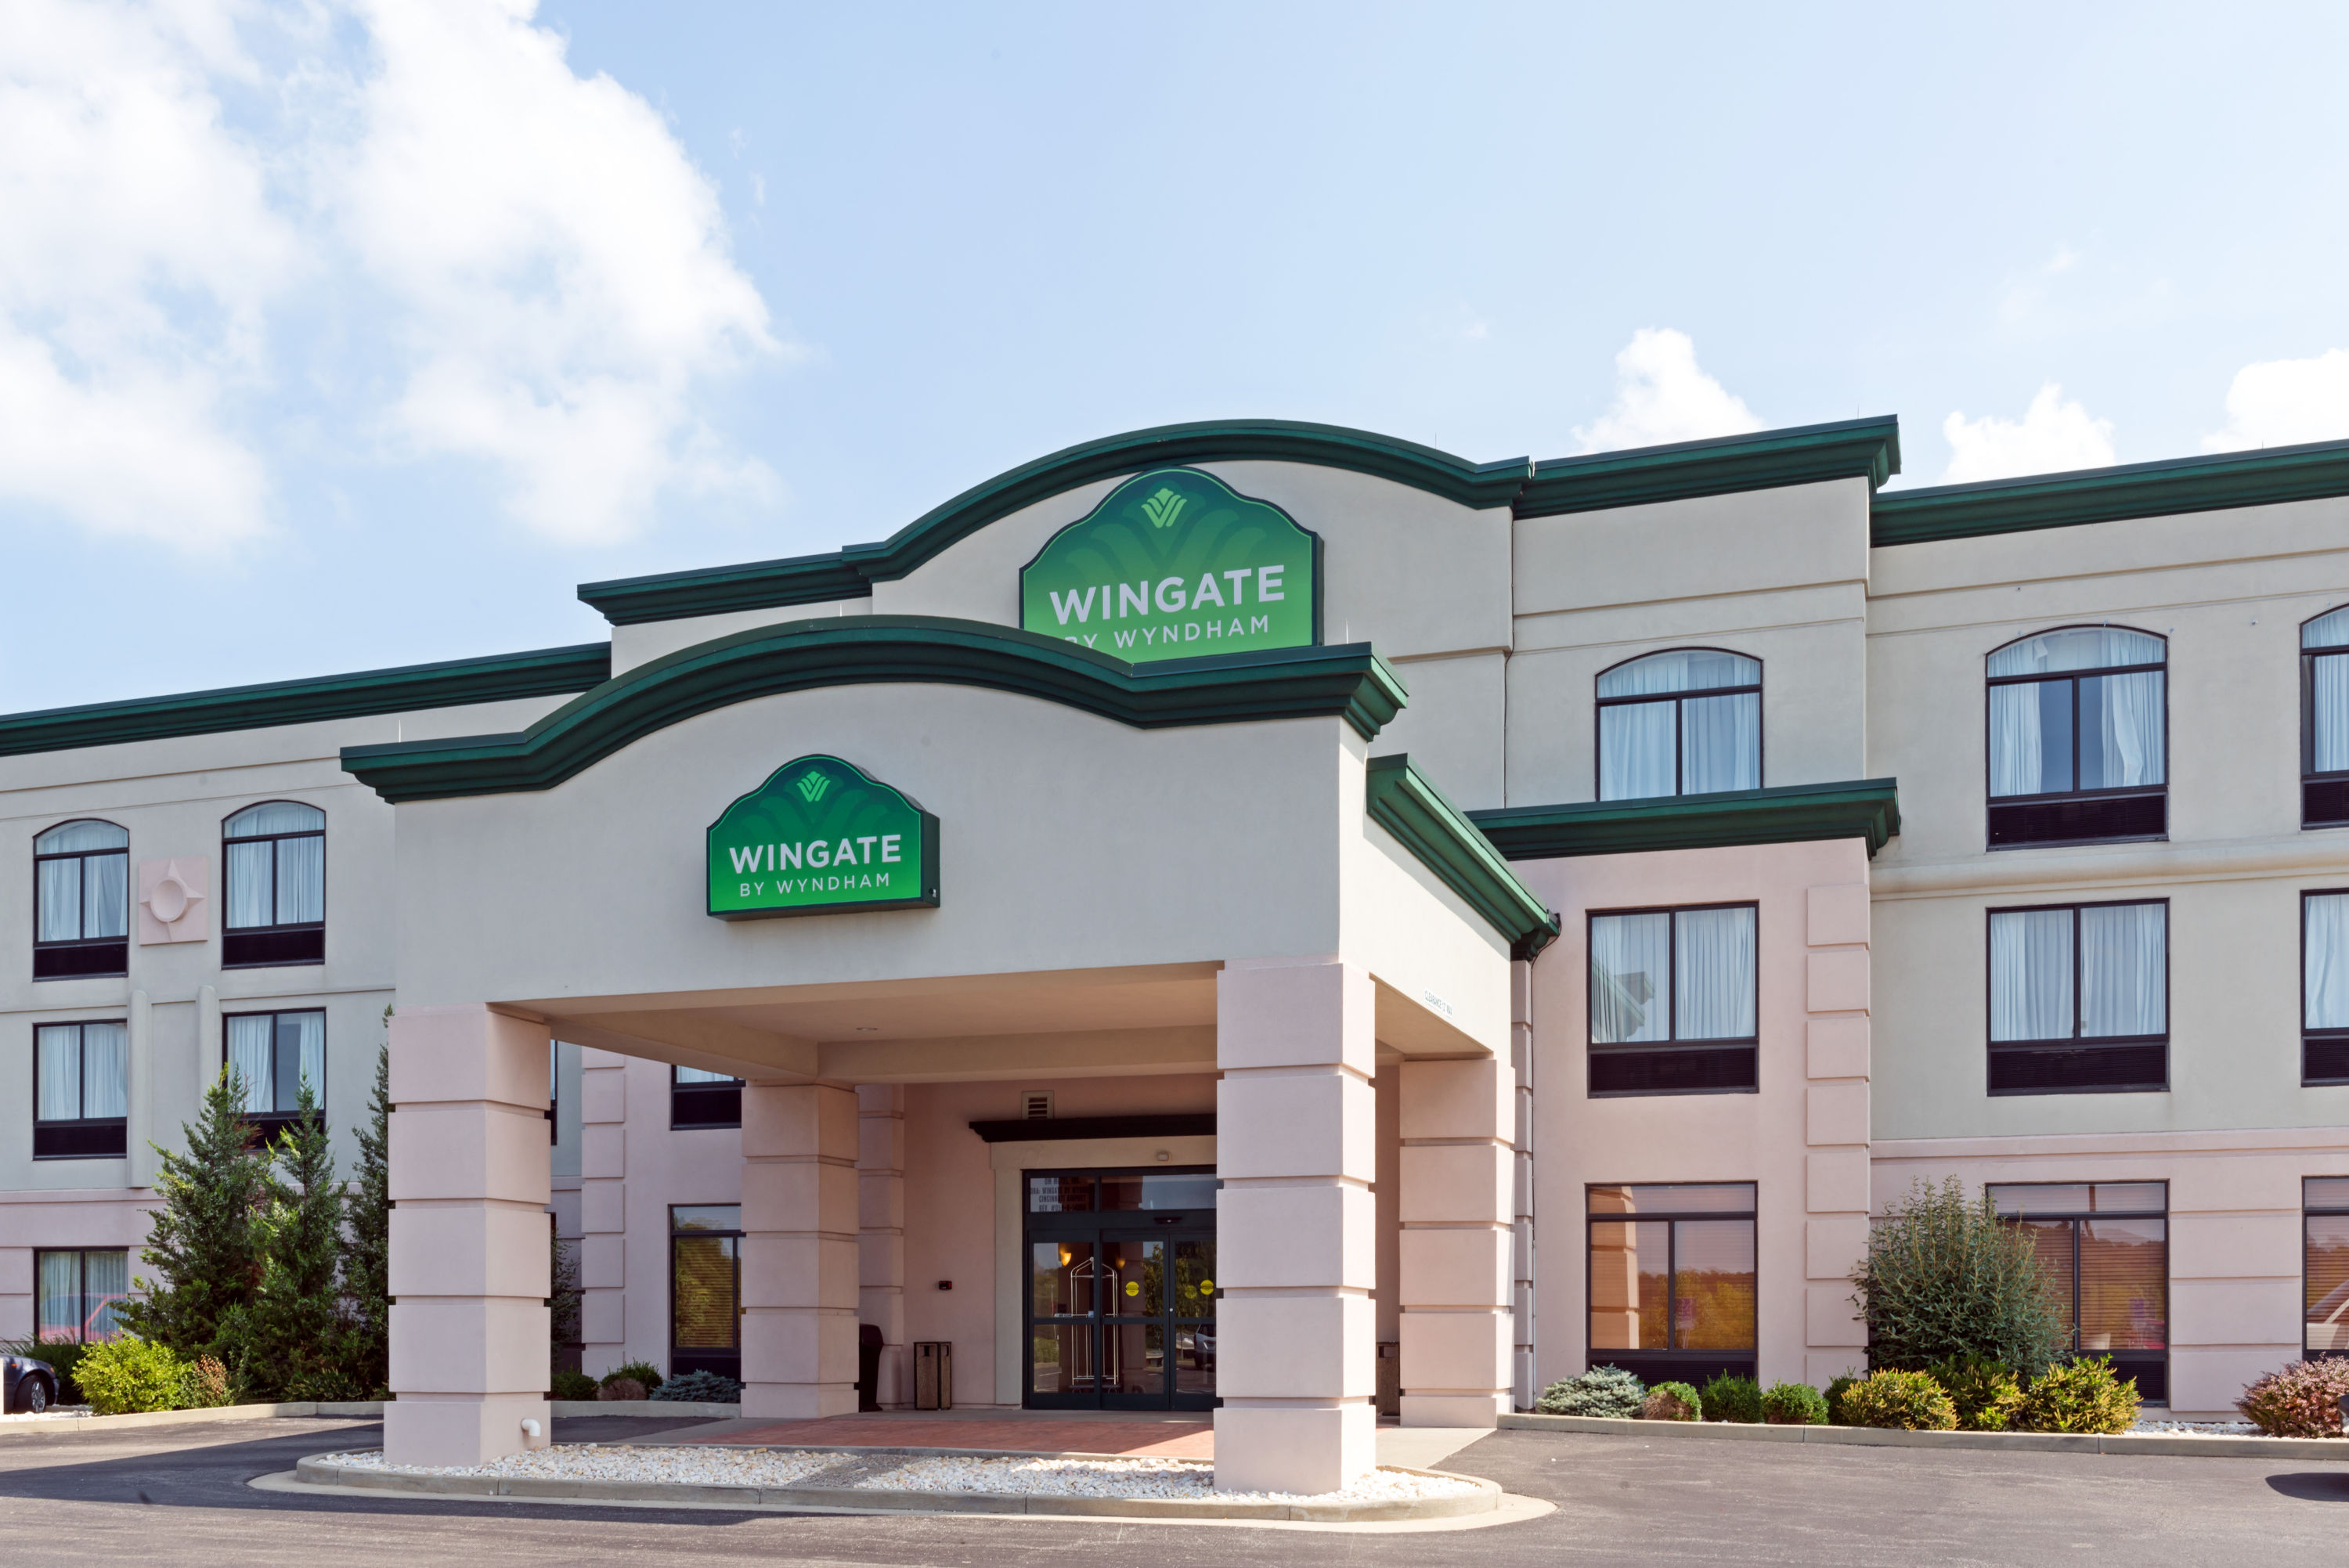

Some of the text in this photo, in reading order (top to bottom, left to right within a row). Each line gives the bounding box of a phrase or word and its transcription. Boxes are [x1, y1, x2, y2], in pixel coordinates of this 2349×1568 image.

[1049, 564, 1285, 625] WINGATE
[1113, 615, 1268, 649] WYNDHAM
[729, 834, 901, 874] WINGATE
[740, 872, 889, 897] BY WYNDHAM
[1424, 989, 1442, 1009] CLEARANCE
